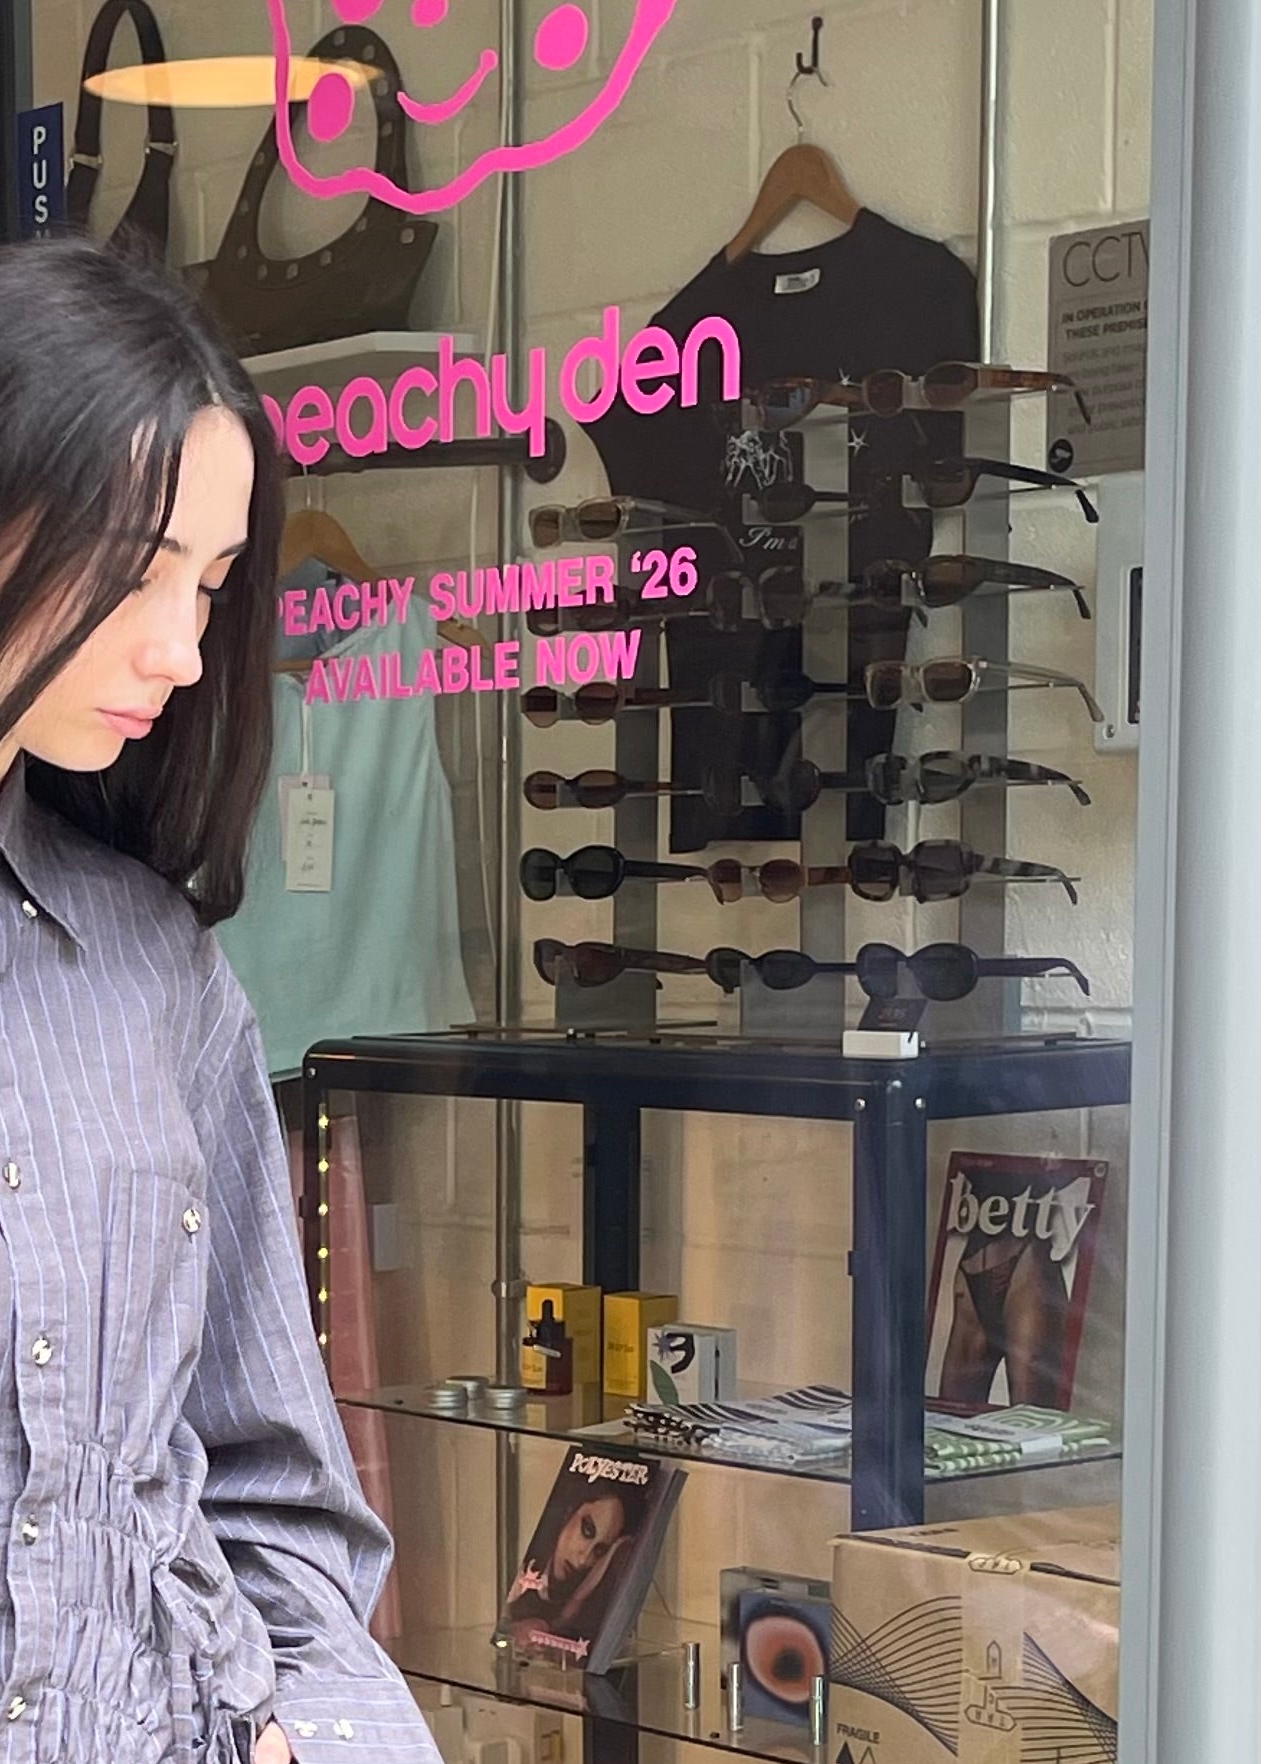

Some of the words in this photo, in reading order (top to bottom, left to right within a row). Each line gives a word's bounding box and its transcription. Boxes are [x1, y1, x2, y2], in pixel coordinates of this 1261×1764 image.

[32, 125, 50, 239] PUS
[1066, 324, 1100, 340] THESE
[1075, 302, 1141, 321] OPERATION
[559, 305, 741, 424] den
[276, 576, 416, 636] EACHY
[428, 555, 616, 621] SUMMER
[304, 641, 521, 705] AVAILABLE
[535, 629, 642, 684] NOW
[946, 1170, 1097, 1262] betty
[569, 1453, 649, 1485] POLYESTER
[836, 1722, 881, 1745] FRAGILE
